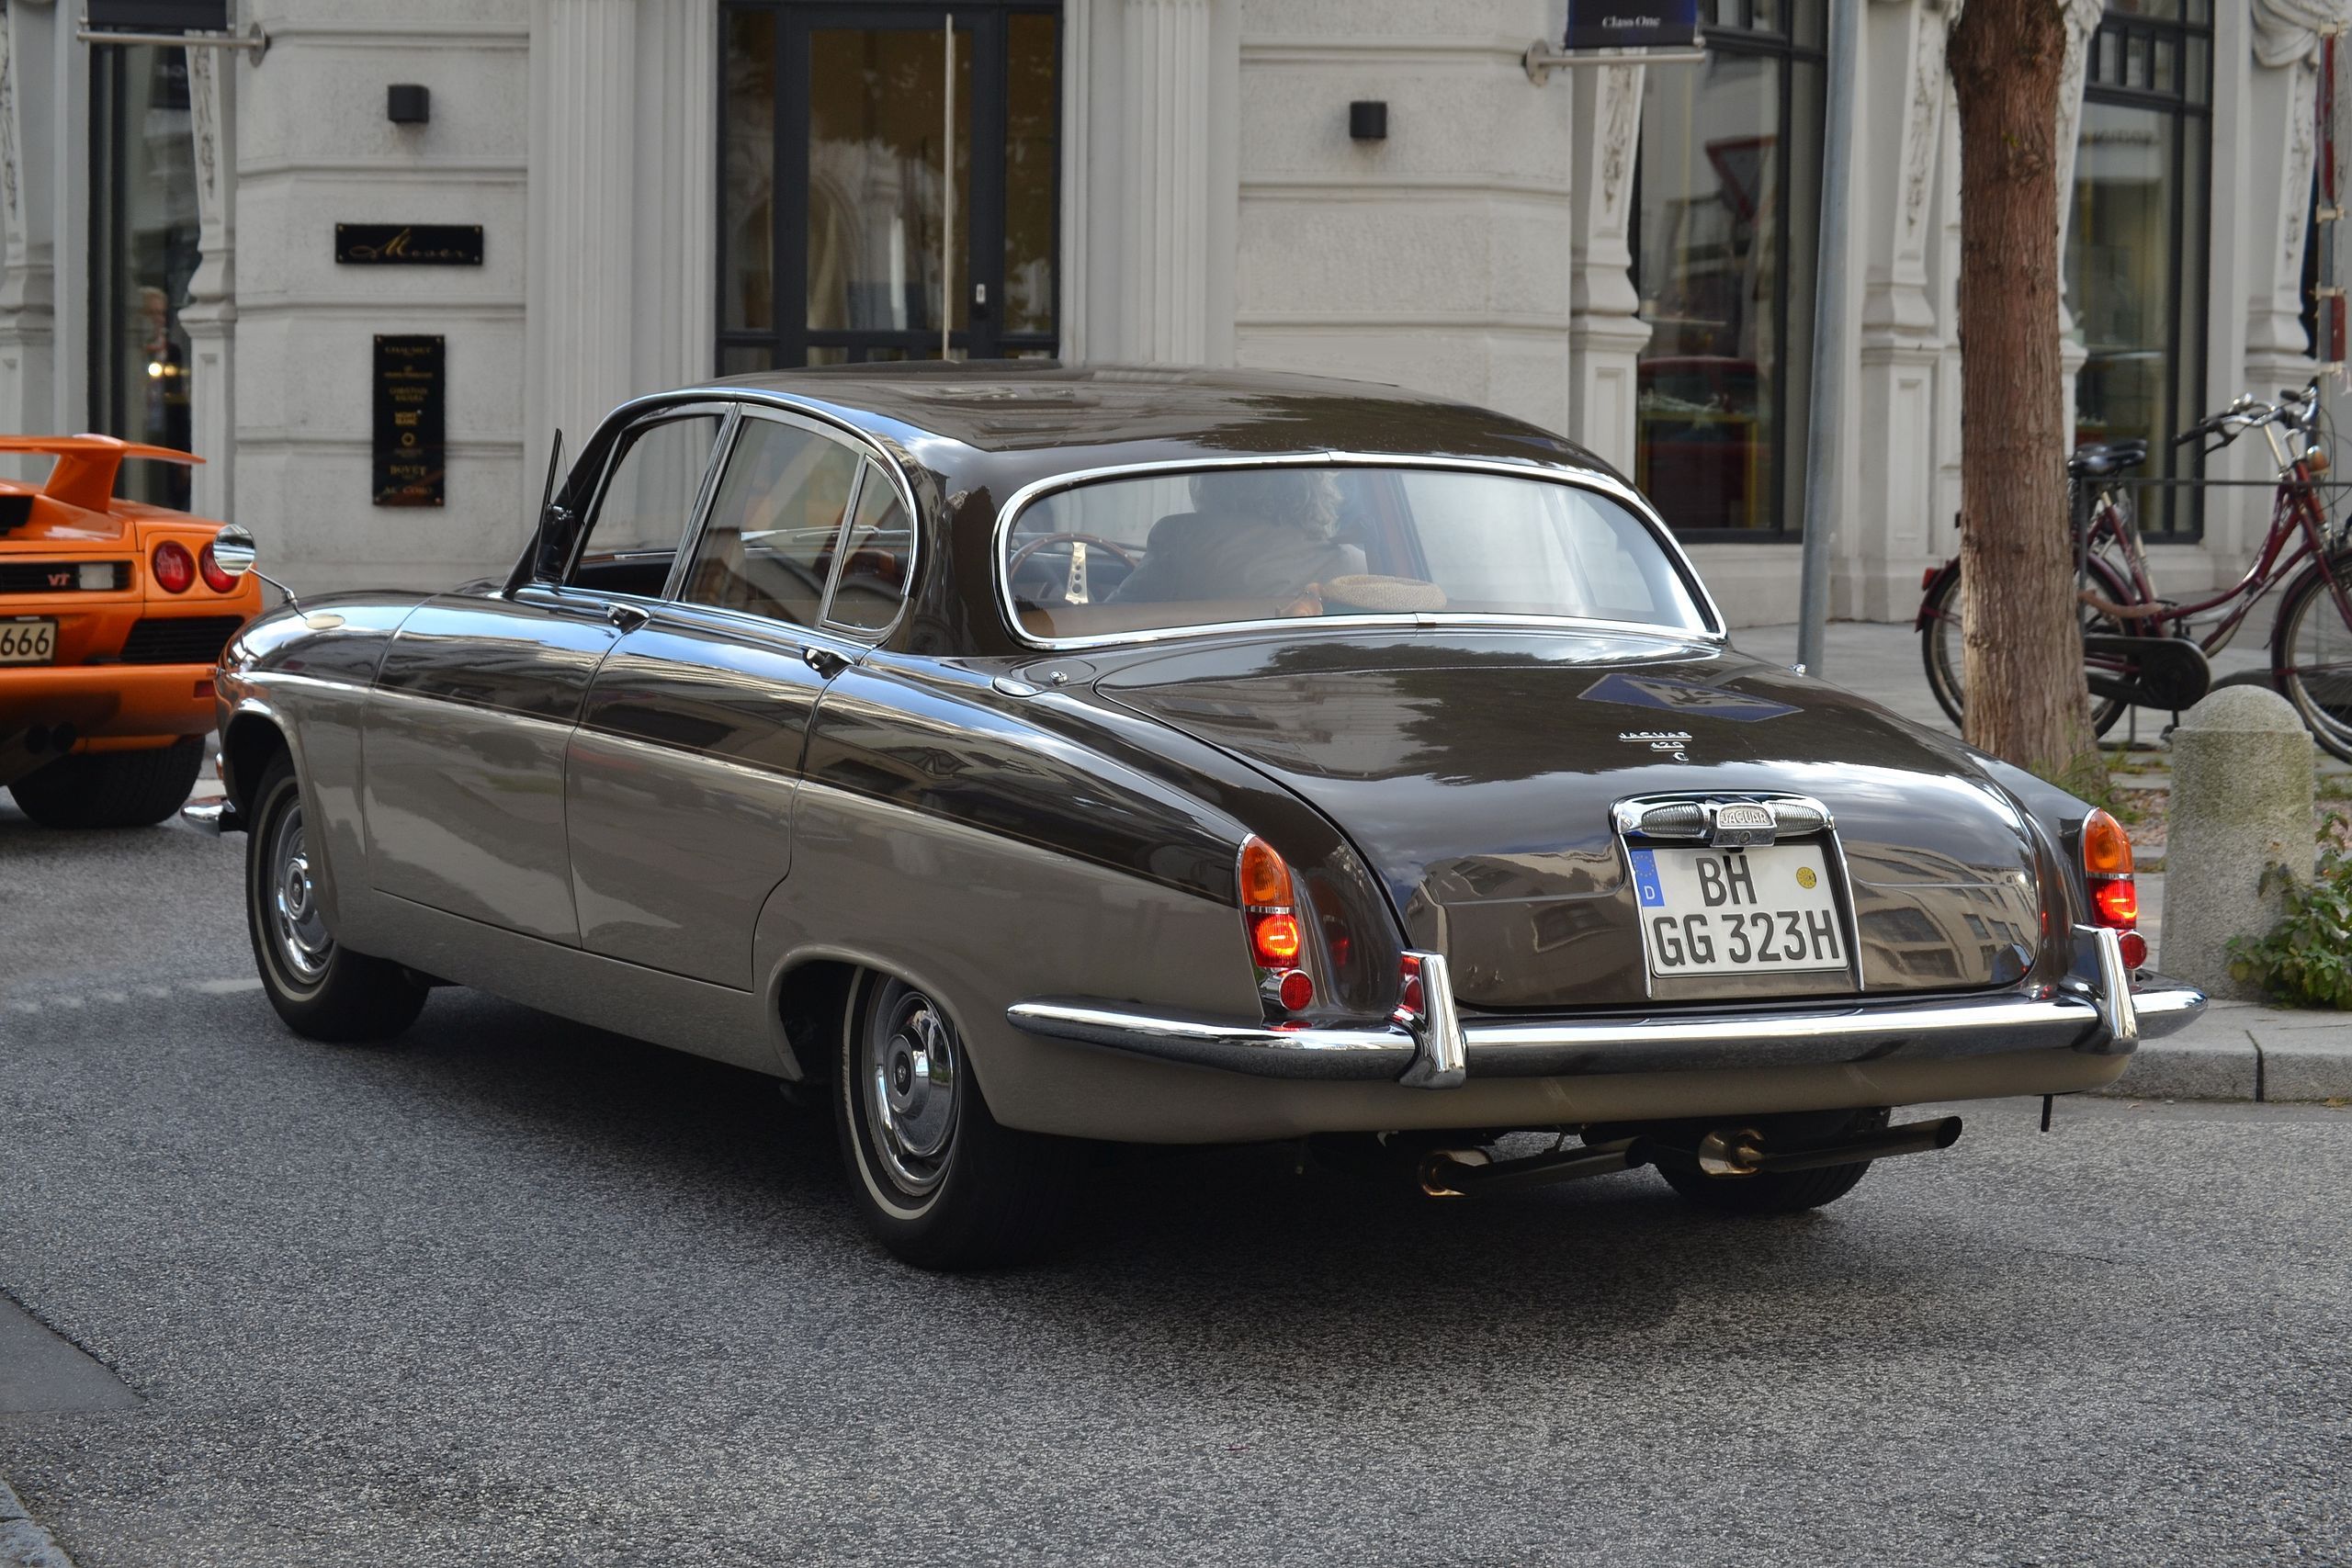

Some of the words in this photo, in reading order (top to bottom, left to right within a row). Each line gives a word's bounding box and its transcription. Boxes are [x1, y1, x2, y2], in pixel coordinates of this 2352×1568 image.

[1635, 15, 1661, 28] One
[47, 573, 71, 586] VT
[0, 627, 51, 656] 666
[1721, 809, 1769, 825] JAGUAR
[1695, 854, 1758, 908] BH
[1645, 886, 1656, 900] D
[1653, 913, 1716, 966] GG
[1722, 909, 1840, 964] 323H
